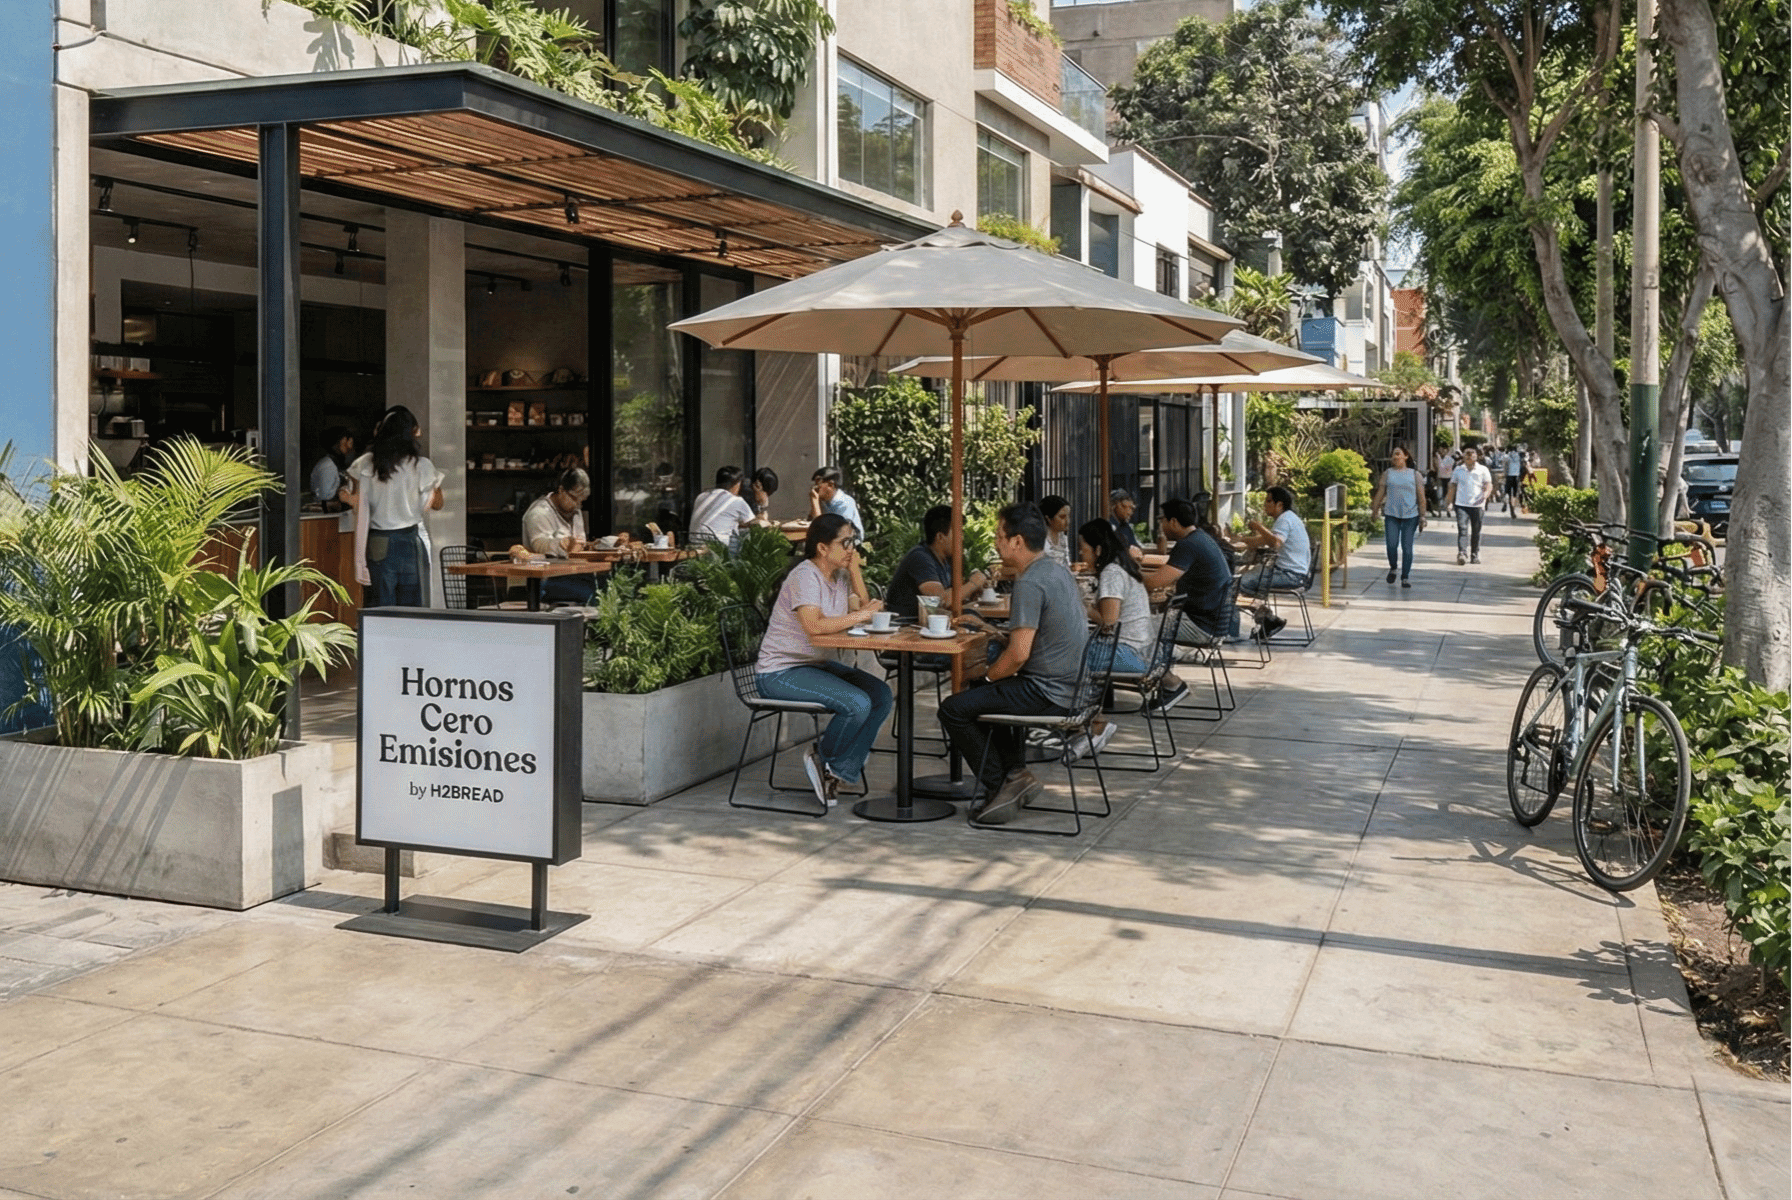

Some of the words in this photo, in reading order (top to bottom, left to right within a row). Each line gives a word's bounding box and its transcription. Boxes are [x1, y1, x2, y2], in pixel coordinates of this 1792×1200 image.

[401, 666, 514, 702] Hornos
[420, 702, 493, 736] Cero
[379, 733, 537, 775] Emisiones
[409, 781, 427, 800] by
[430, 783, 504, 804] H2BREAD
